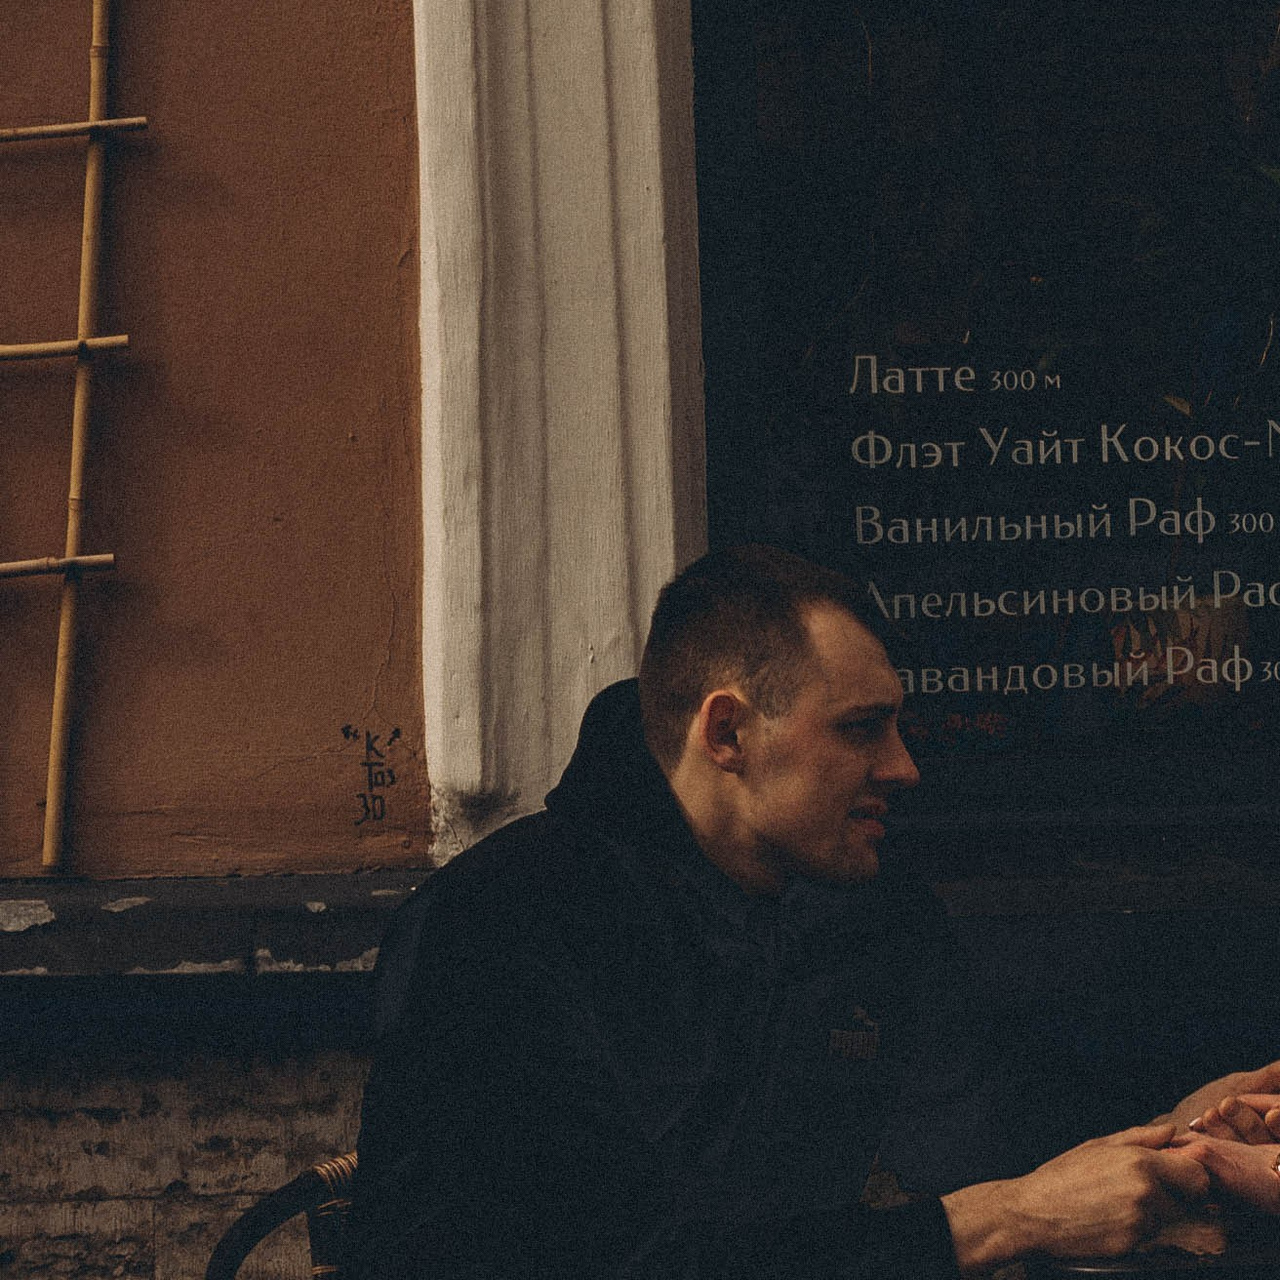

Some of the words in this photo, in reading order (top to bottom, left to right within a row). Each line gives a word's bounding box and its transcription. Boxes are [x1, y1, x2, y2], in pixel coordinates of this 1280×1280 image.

[850, 355, 977, 394] Латте
[990, 370, 1036, 391] 300
[851, 430, 966, 468] Флэт
[979, 426, 1085, 465] Уайт
[855, 503, 1112, 544] Ванильный
[1129, 497, 1216, 543] Раф
[1229, 512, 1274, 533] 300
[898, 652, 1149, 695] авандовый
[1166, 645, 1253, 692] Раф
